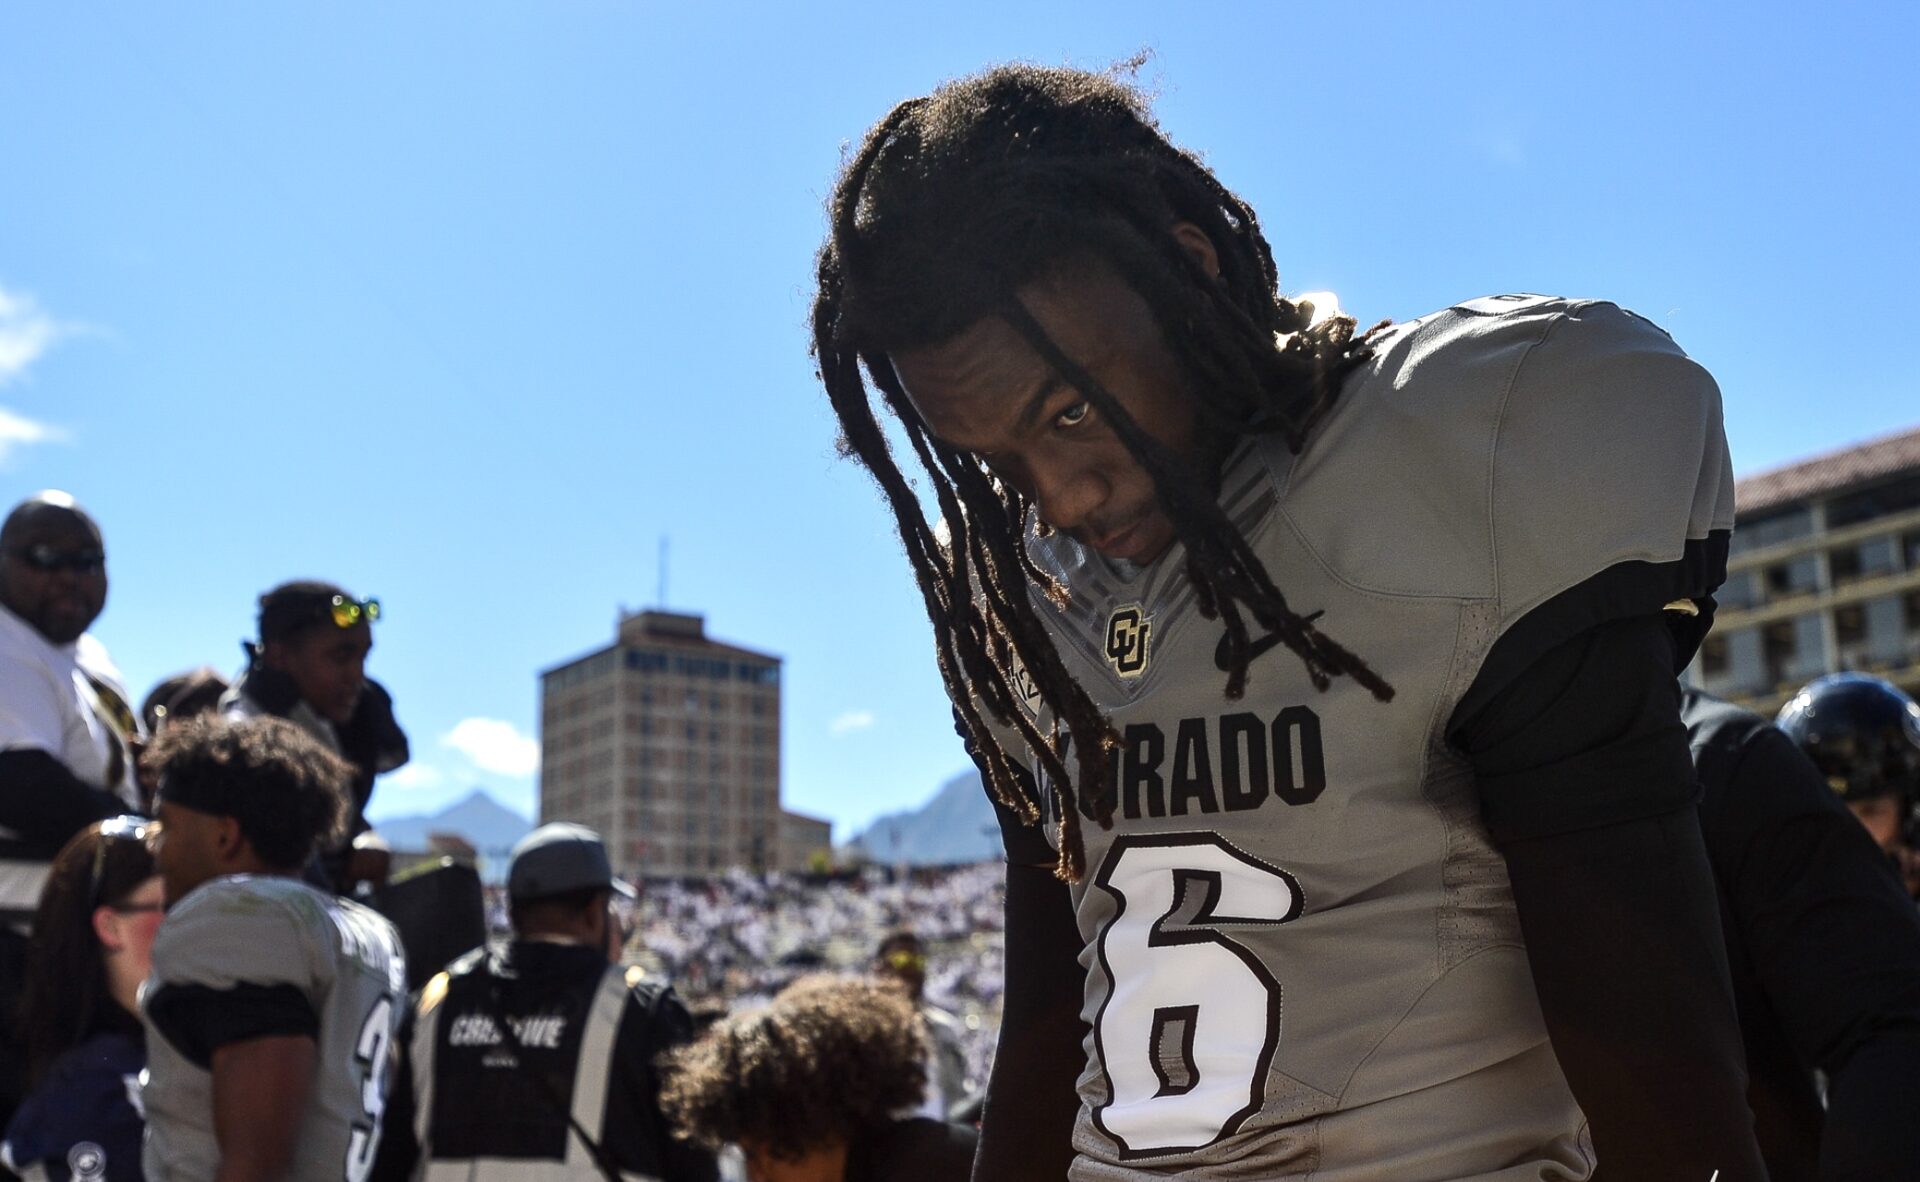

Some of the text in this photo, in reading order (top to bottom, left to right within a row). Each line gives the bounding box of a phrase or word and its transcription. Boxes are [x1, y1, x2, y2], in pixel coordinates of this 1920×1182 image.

[1106, 608, 1150, 675] CU
[346, 994, 393, 1182] 3
[1093, 831, 1305, 1160] 6
